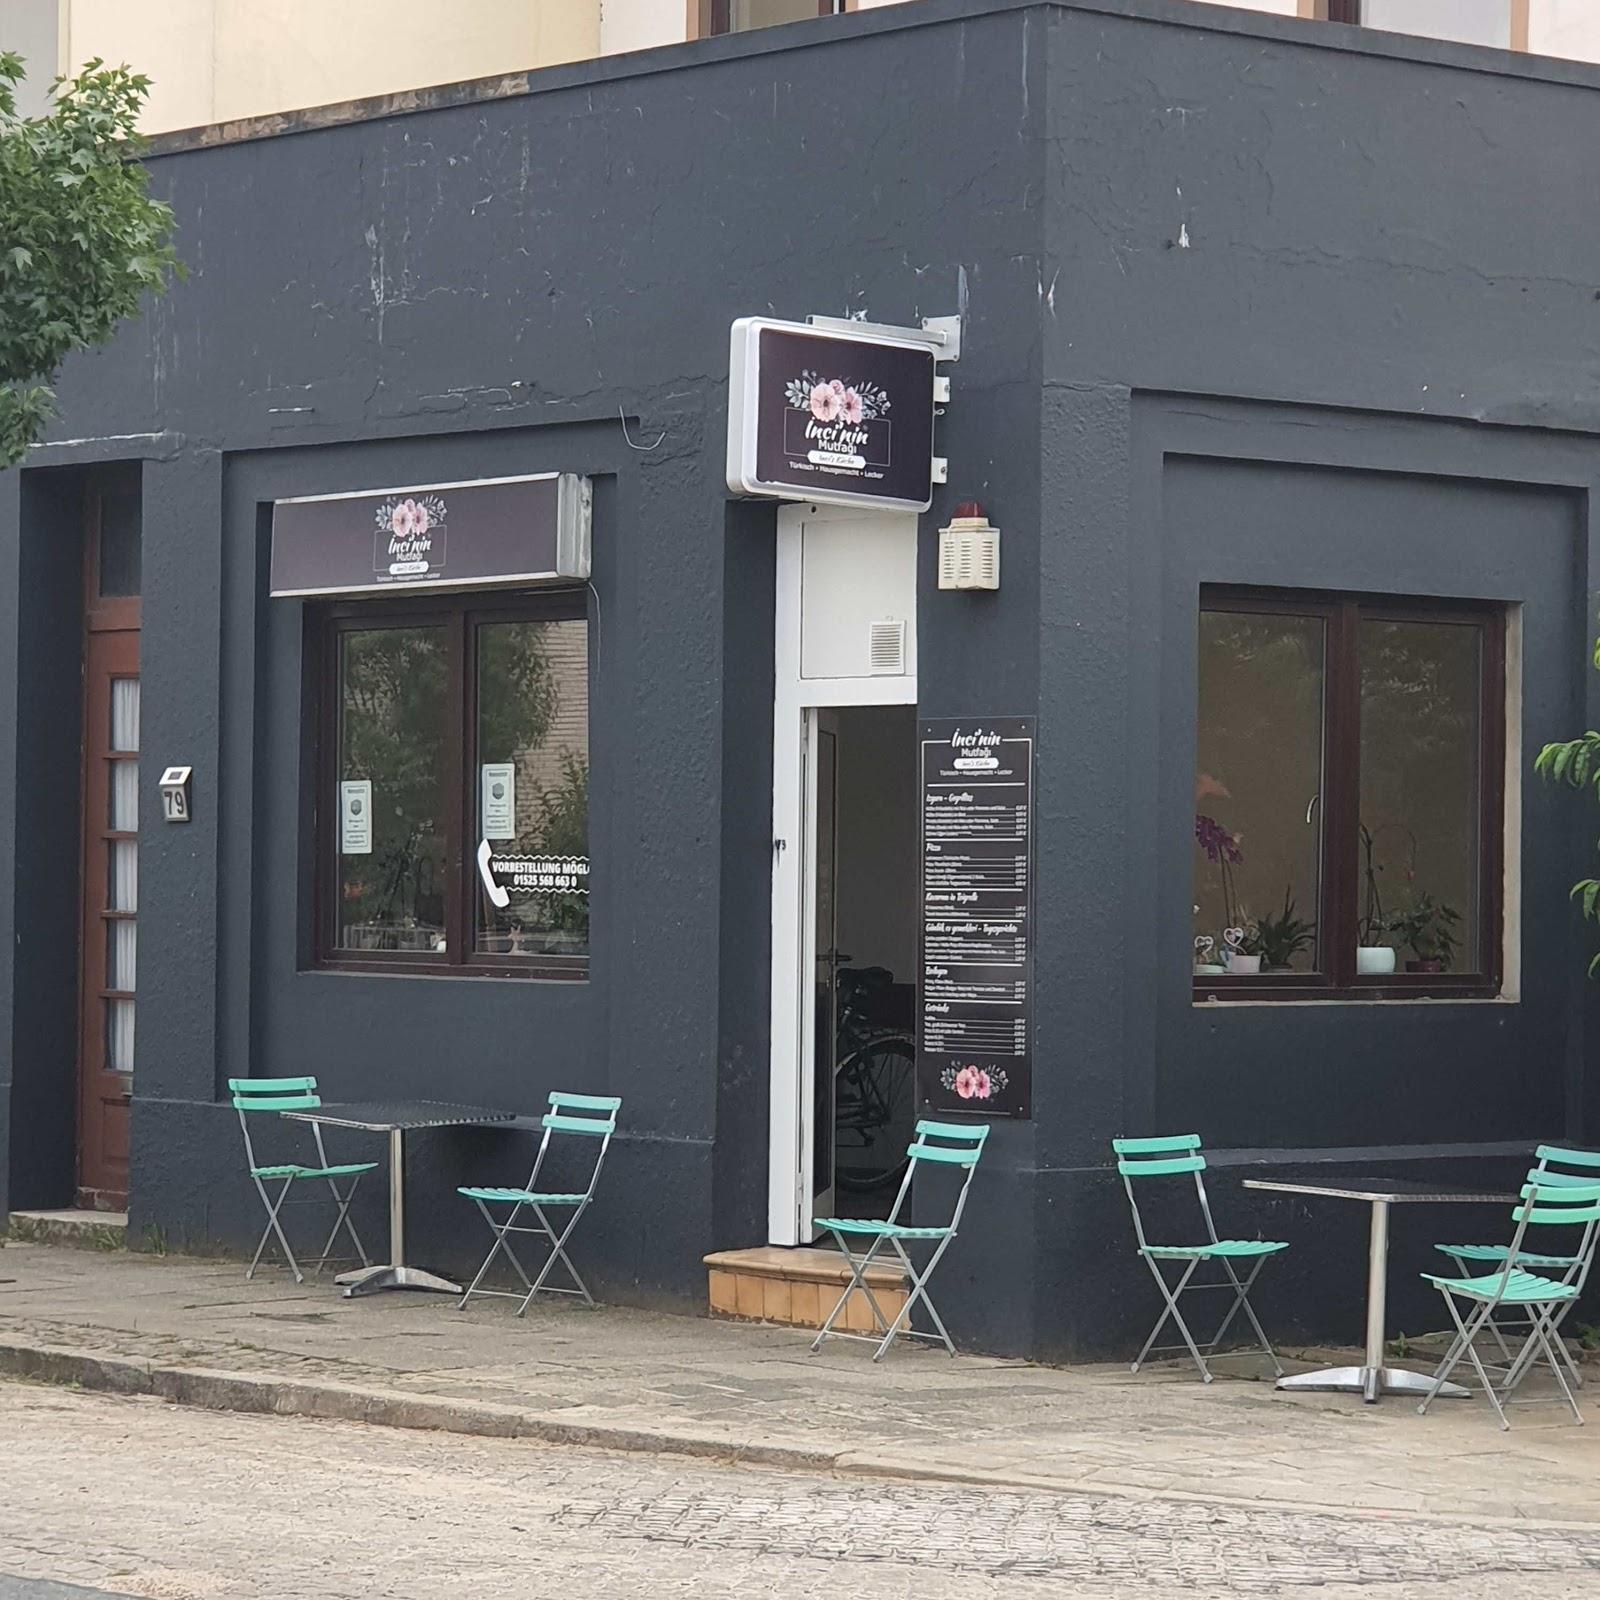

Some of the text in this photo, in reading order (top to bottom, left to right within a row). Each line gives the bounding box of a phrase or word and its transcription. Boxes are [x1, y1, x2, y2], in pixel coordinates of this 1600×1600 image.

[164, 791, 184, 815] 79
[492, 861, 561, 874] VORBESTELLUNG
[513, 874, 578, 887] 01525 568 663 0
